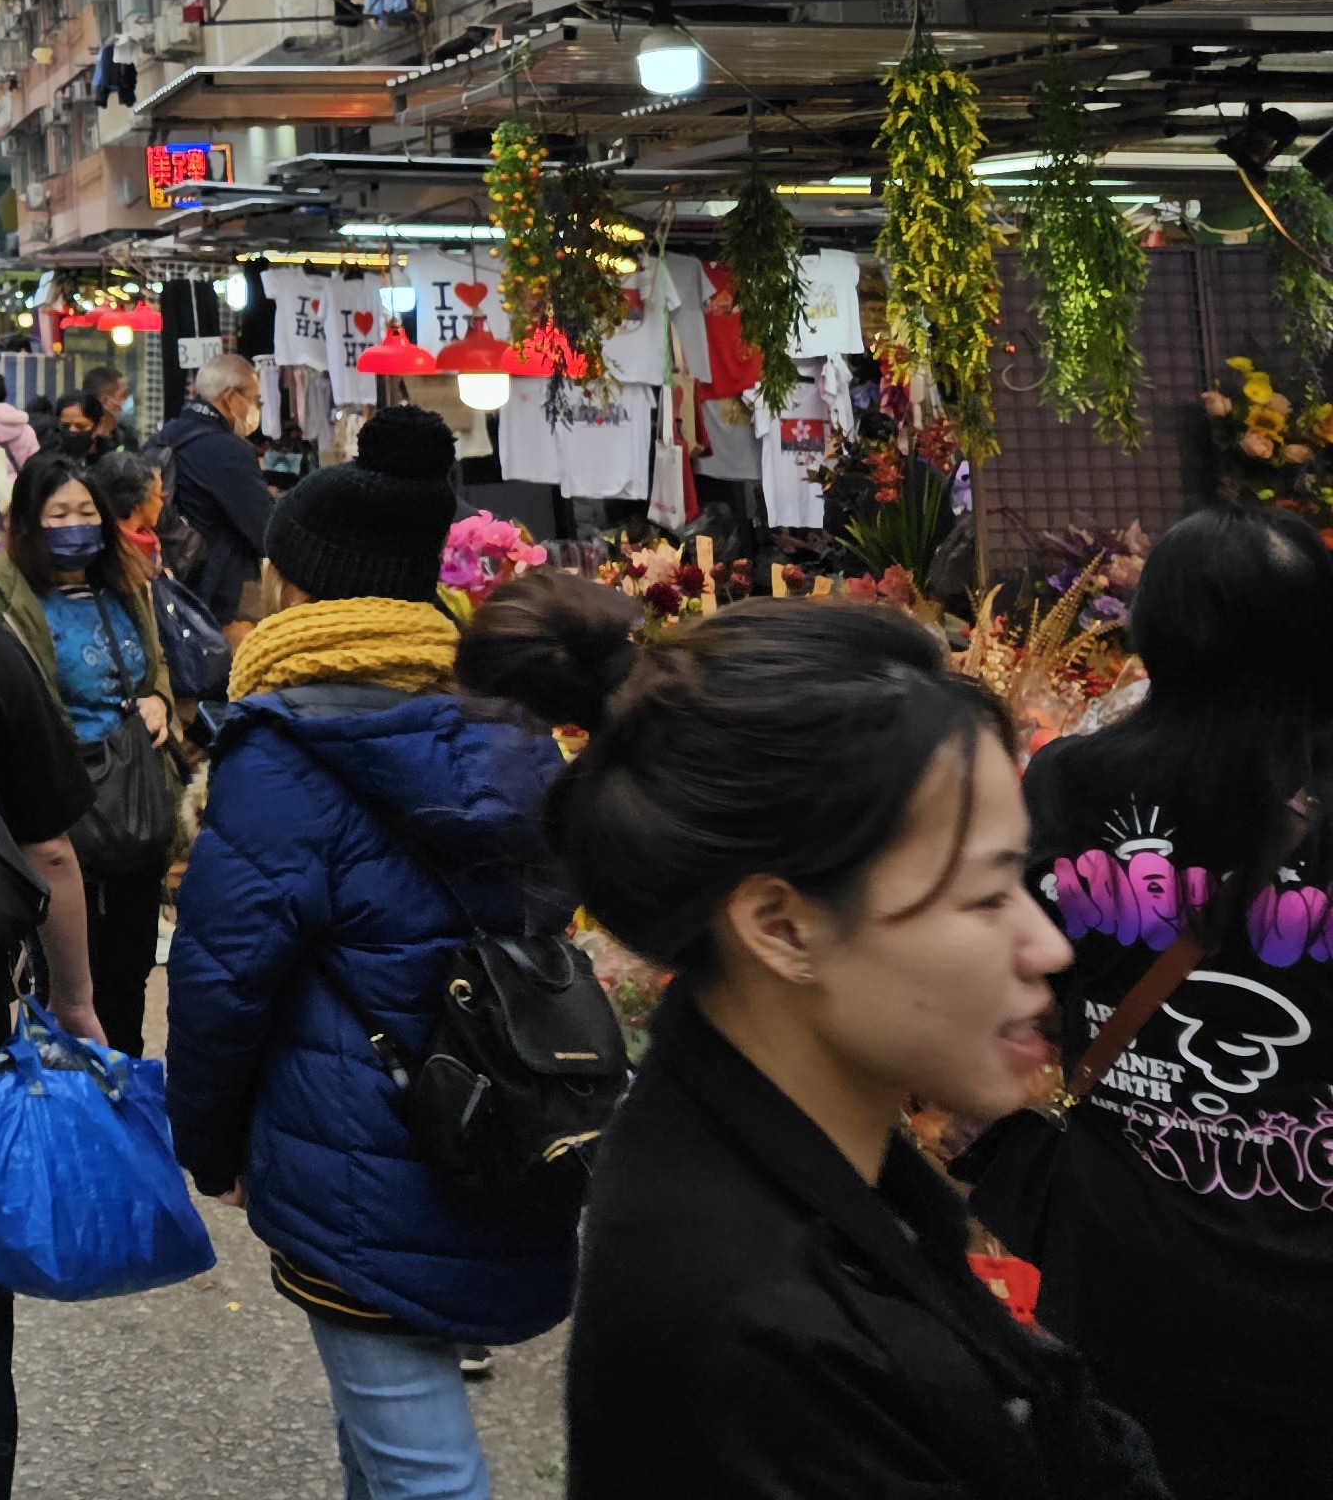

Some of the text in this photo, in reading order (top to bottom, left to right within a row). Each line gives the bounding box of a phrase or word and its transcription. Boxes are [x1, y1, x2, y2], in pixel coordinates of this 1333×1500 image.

[296, 295, 311, 316] I
[431, 281, 454, 311] I
[340, 309, 353, 339] I
[1083, 999, 1117, 1023] AP
[1114, 1051, 1186, 1083] ANET
[1100, 1067, 1173, 1103] ARTH
